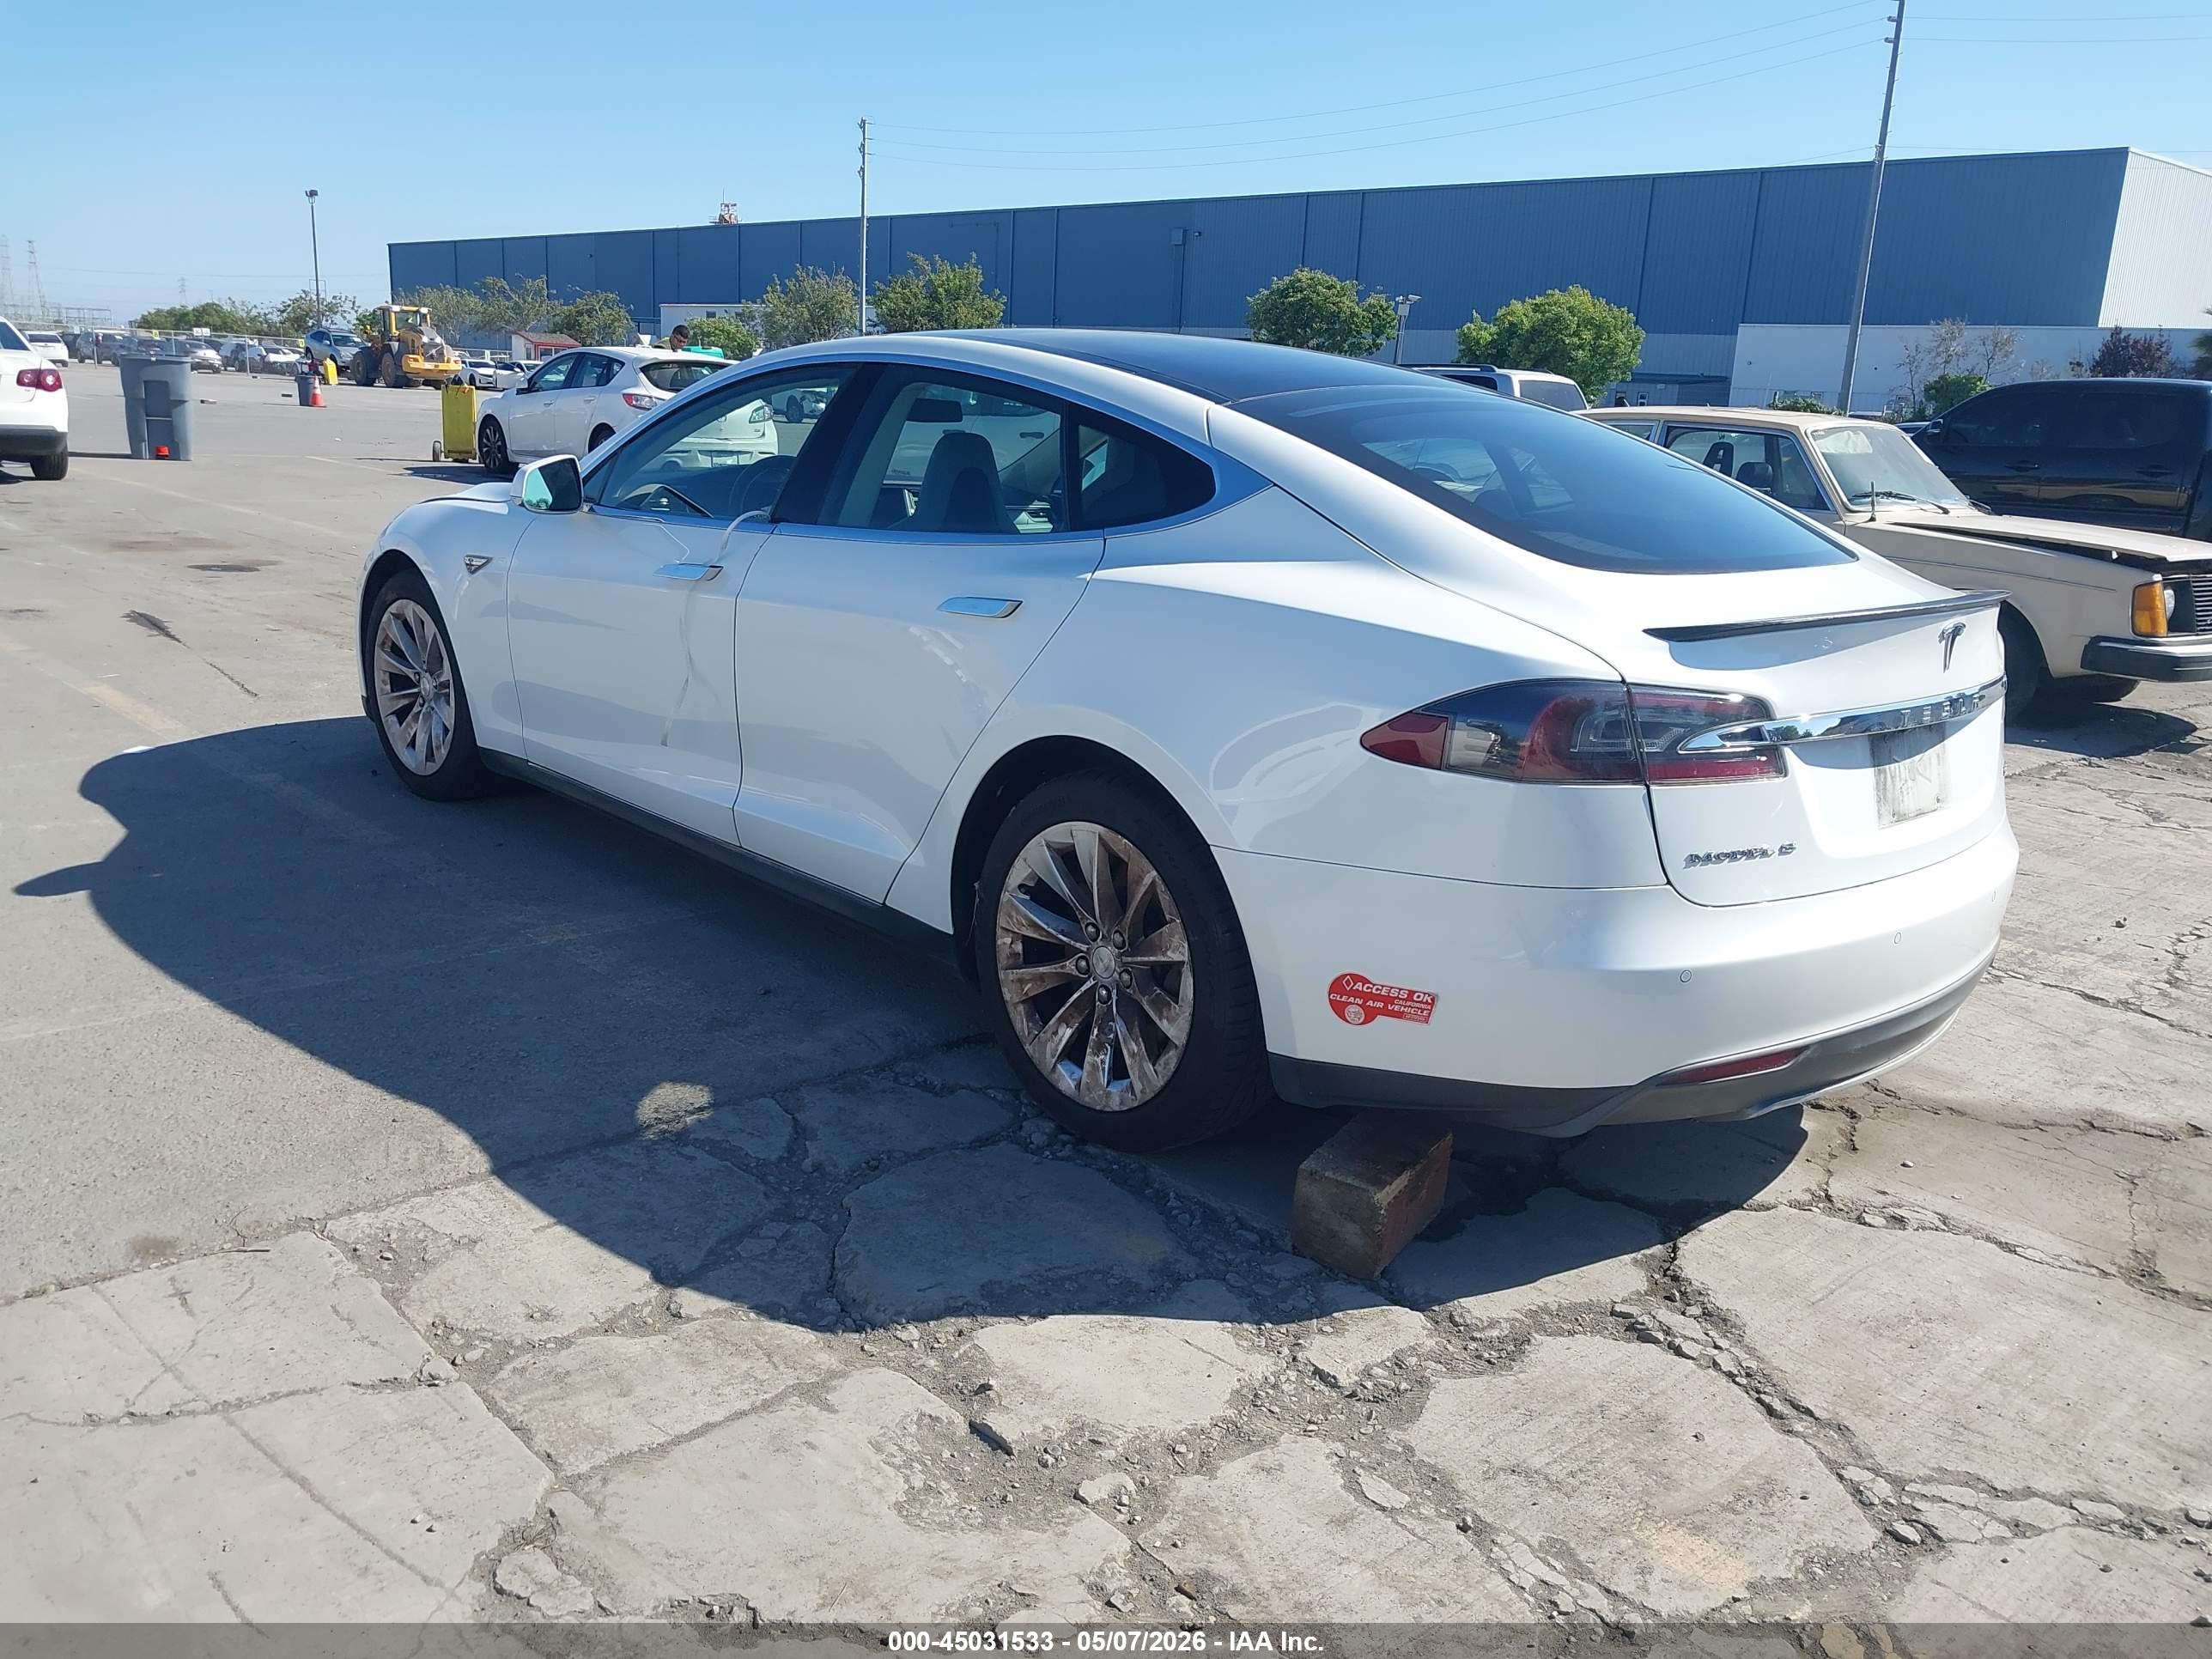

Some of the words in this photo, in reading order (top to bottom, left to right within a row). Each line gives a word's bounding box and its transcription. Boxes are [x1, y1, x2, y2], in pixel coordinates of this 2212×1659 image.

[1352, 981, 1408, 999] ACCESS
[1413, 992, 1433, 1003] OK
[1329, 993, 1364, 1005] CLEAN
[1365, 1000, 1384, 1009] AIR
[1388, 1003, 1431, 1017] VEHICLE
[1394, 999, 1431, 1010] CALIFORNIA
